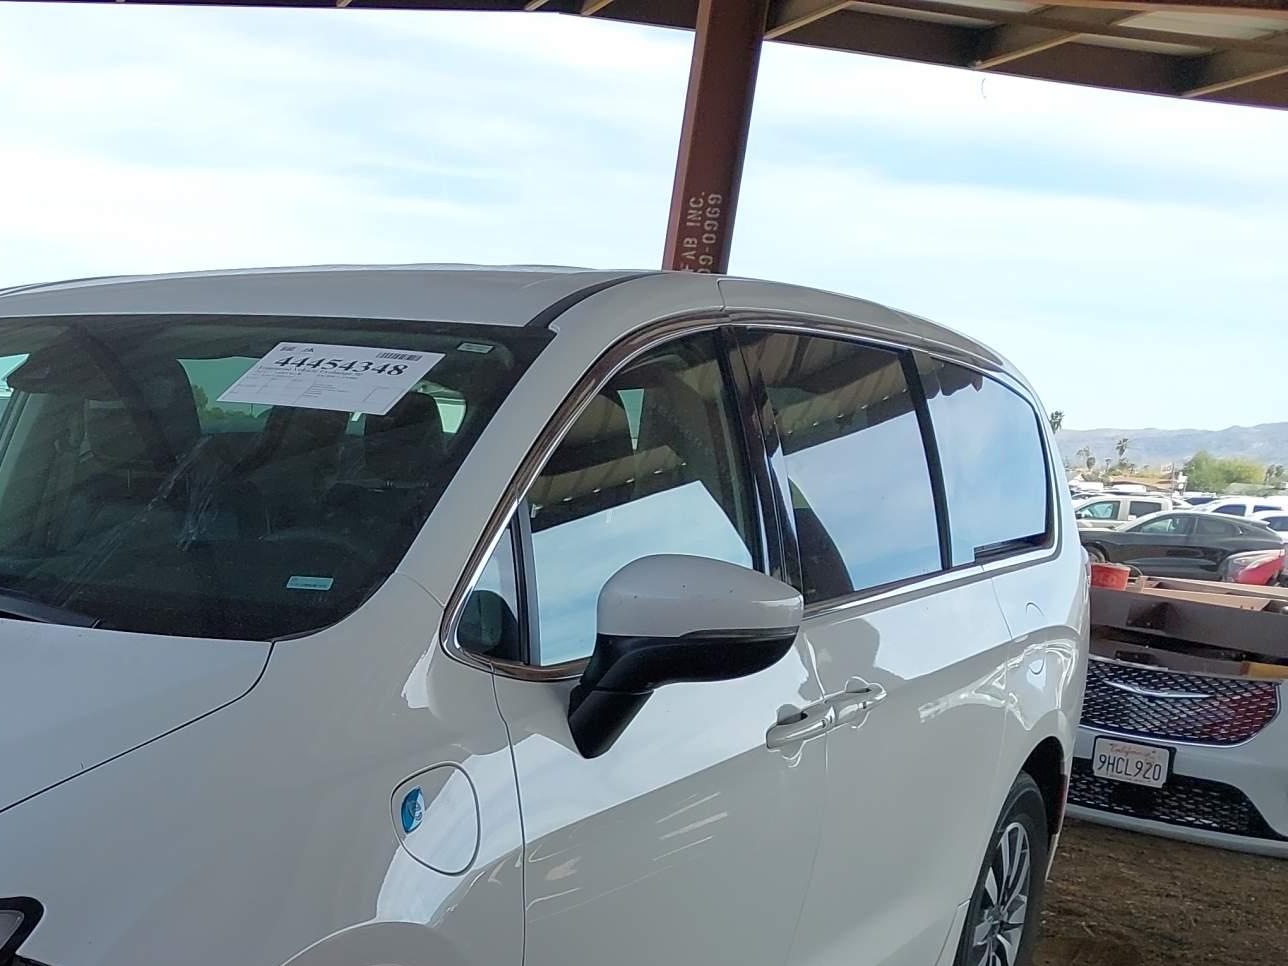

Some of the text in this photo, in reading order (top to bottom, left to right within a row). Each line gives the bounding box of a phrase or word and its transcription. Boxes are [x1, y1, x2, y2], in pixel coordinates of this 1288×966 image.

[686, 192, 705, 226] INC.
[274, 356, 409, 376] 44454348
[1097, 754, 1162, 781] 9HCL920
